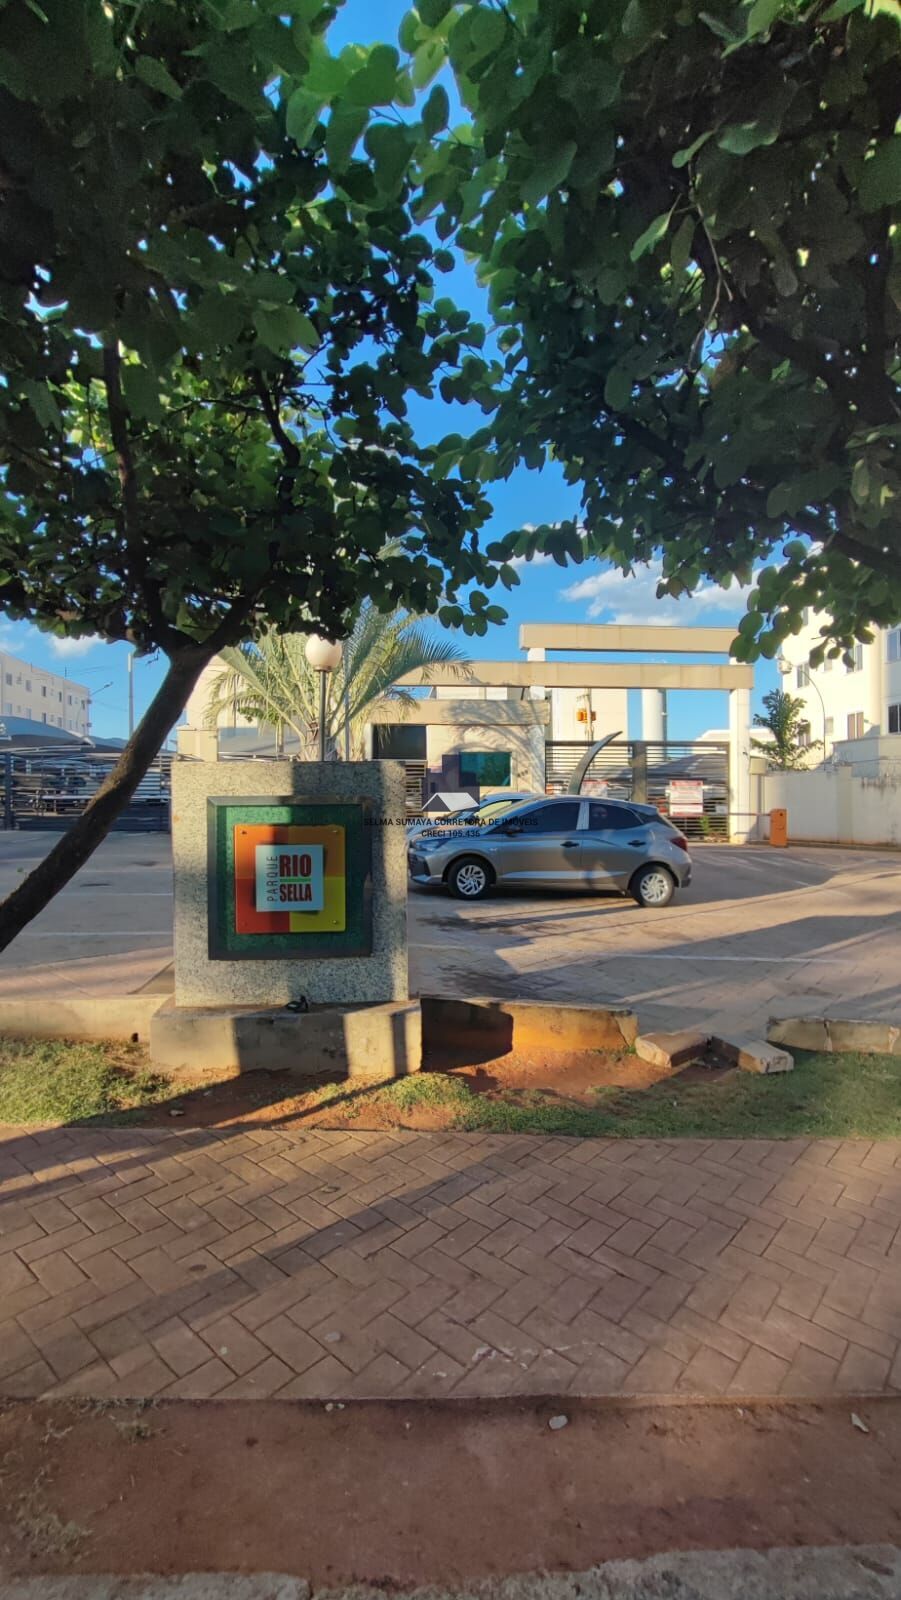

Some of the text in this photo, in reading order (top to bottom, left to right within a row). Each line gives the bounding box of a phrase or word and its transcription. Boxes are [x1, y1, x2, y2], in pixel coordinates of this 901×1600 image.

[279, 854, 312, 877] RIO
[266, 855, 278, 902] PARQUE
[279, 883, 312, 902] SELLA
